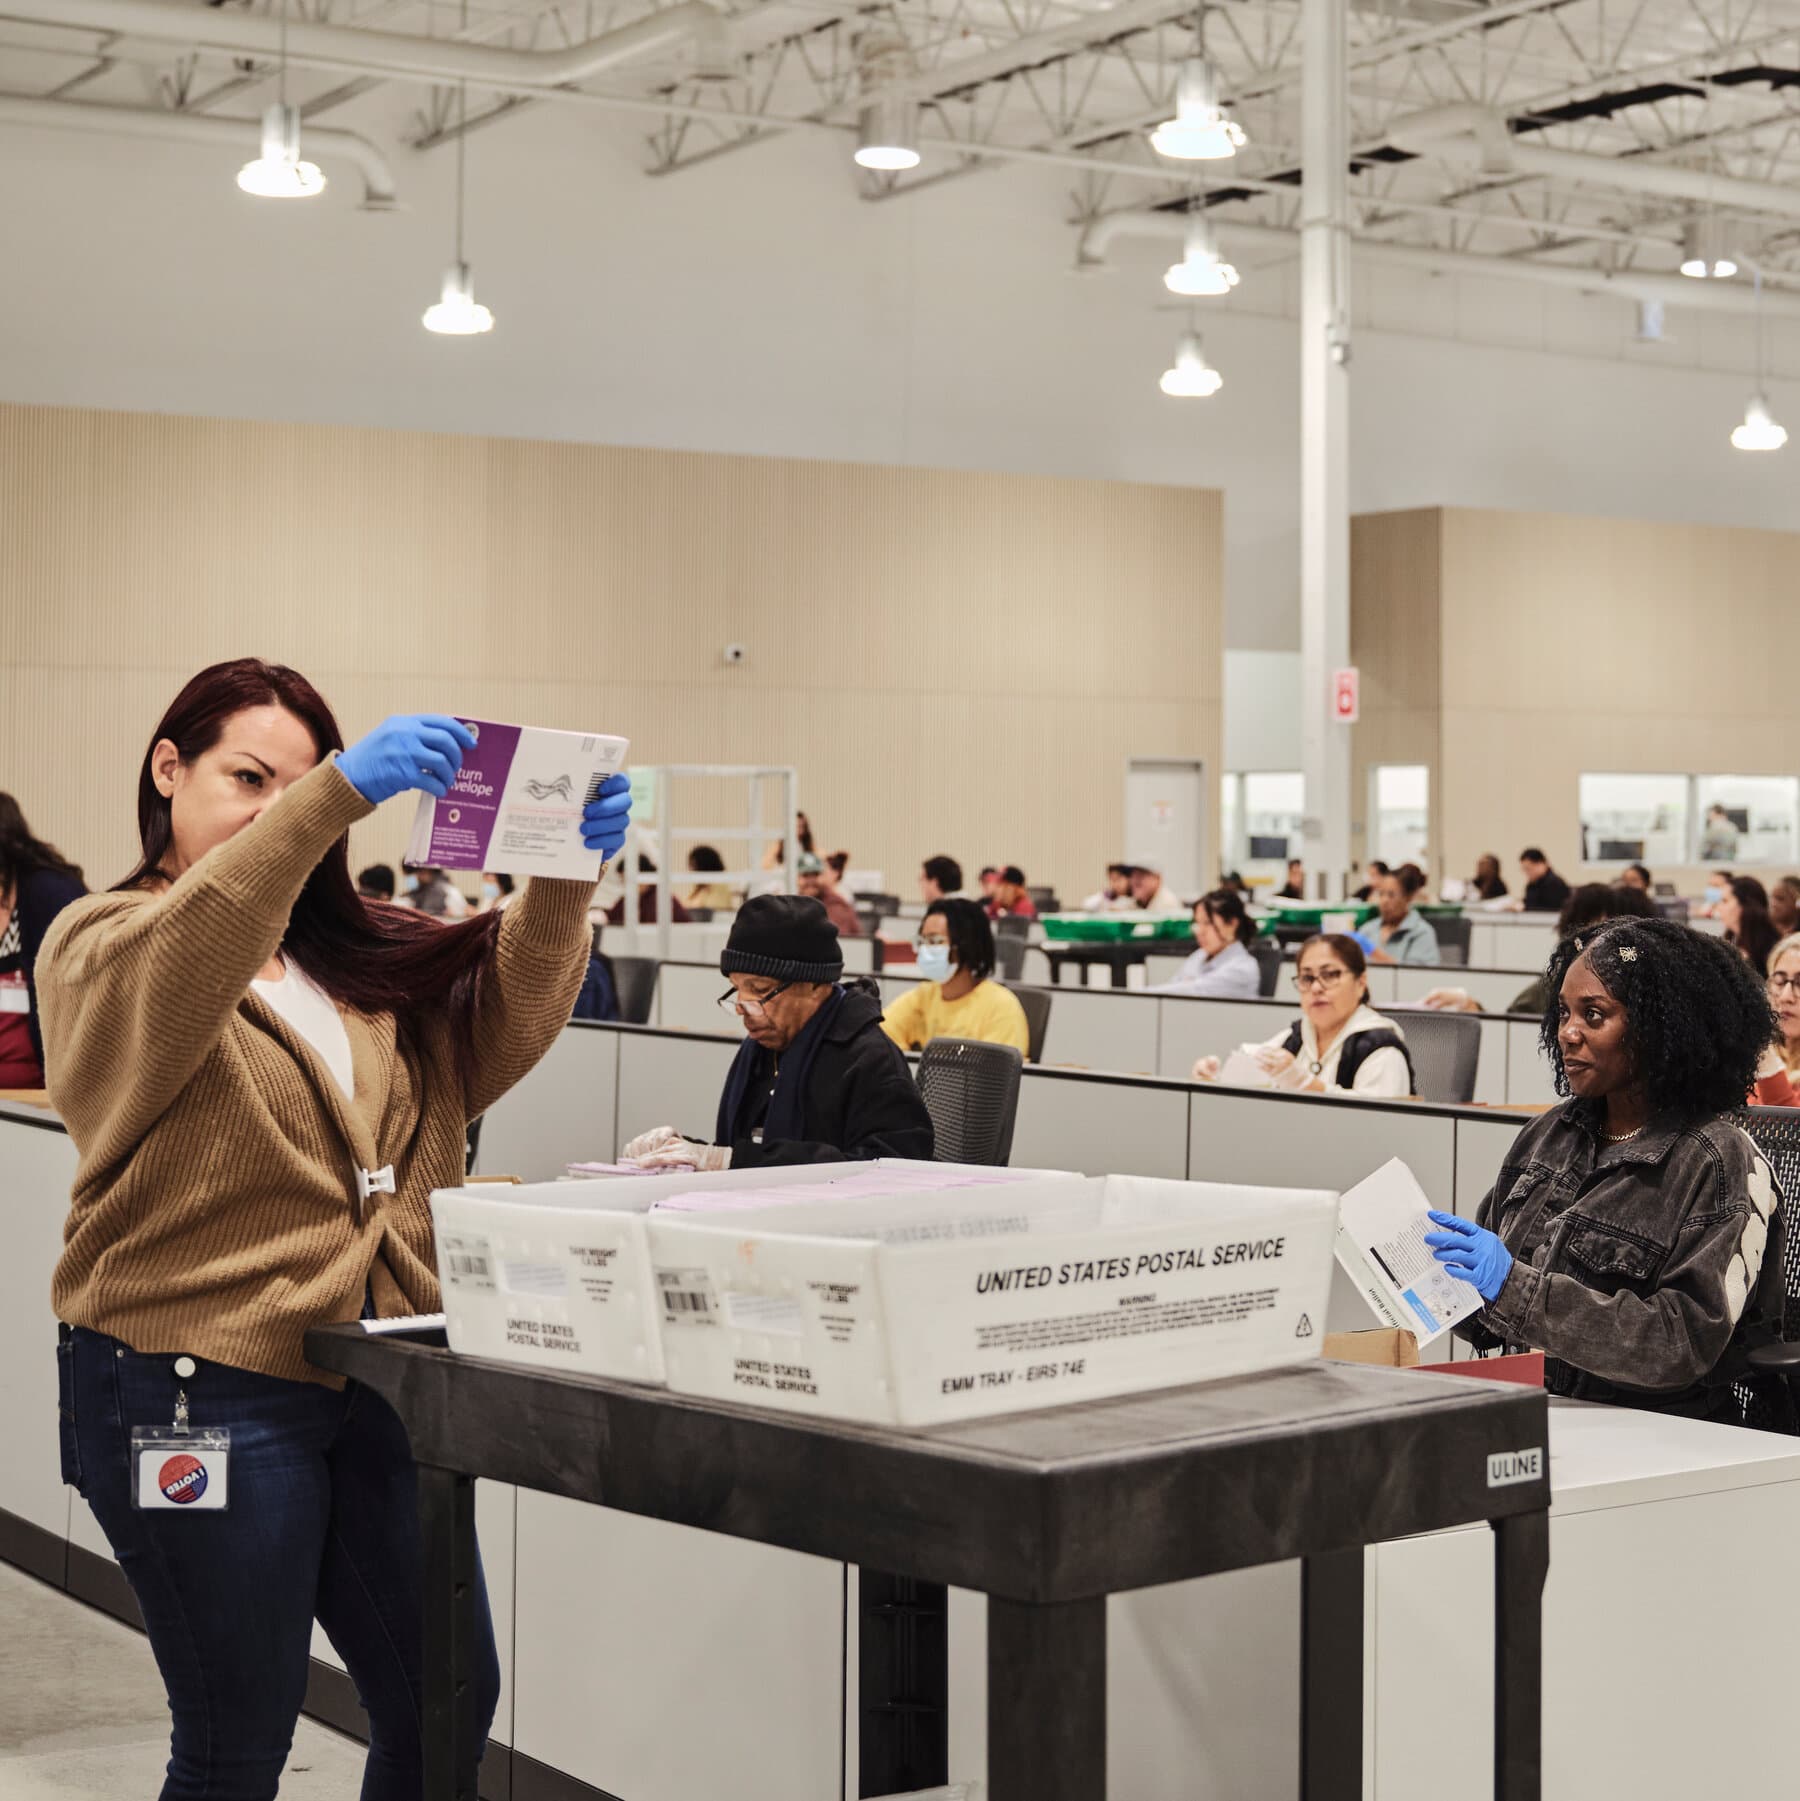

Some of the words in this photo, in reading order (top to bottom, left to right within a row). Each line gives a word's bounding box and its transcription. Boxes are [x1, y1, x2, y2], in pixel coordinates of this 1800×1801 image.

[457, 767, 483, 781] turn
[976, 1266, 1052, 1294] UNITED
[1058, 1256, 1130, 1285] STATES
[1135, 1247, 1206, 1276] POSTAL
[1211, 1237, 1286, 1266] SERVICE
[506, 1318, 540, 1334] UNITED
[541, 1322, 575, 1338] STATES
[1383, 1308, 1401, 1329] fficial
[506, 1332, 541, 1348] POSTAL
[543, 1338, 582, 1353] SERVICE
[733, 1358, 770, 1375] UNITED
[773, 1363, 812, 1380] STATES
[941, 1374, 975, 1394] EMM
[979, 1369, 1015, 1388] TRAY
[1026, 1362, 1058, 1382] EIRS
[1062, 1358, 1086, 1376] 74E
[733, 1371, 771, 1389] POSTAL
[775, 1379, 819, 1397] SERVICE
[198, 1467, 205, 1477] I
[1492, 1454, 1538, 1480] ULINE
[165, 1471, 200, 1496] VOTED
